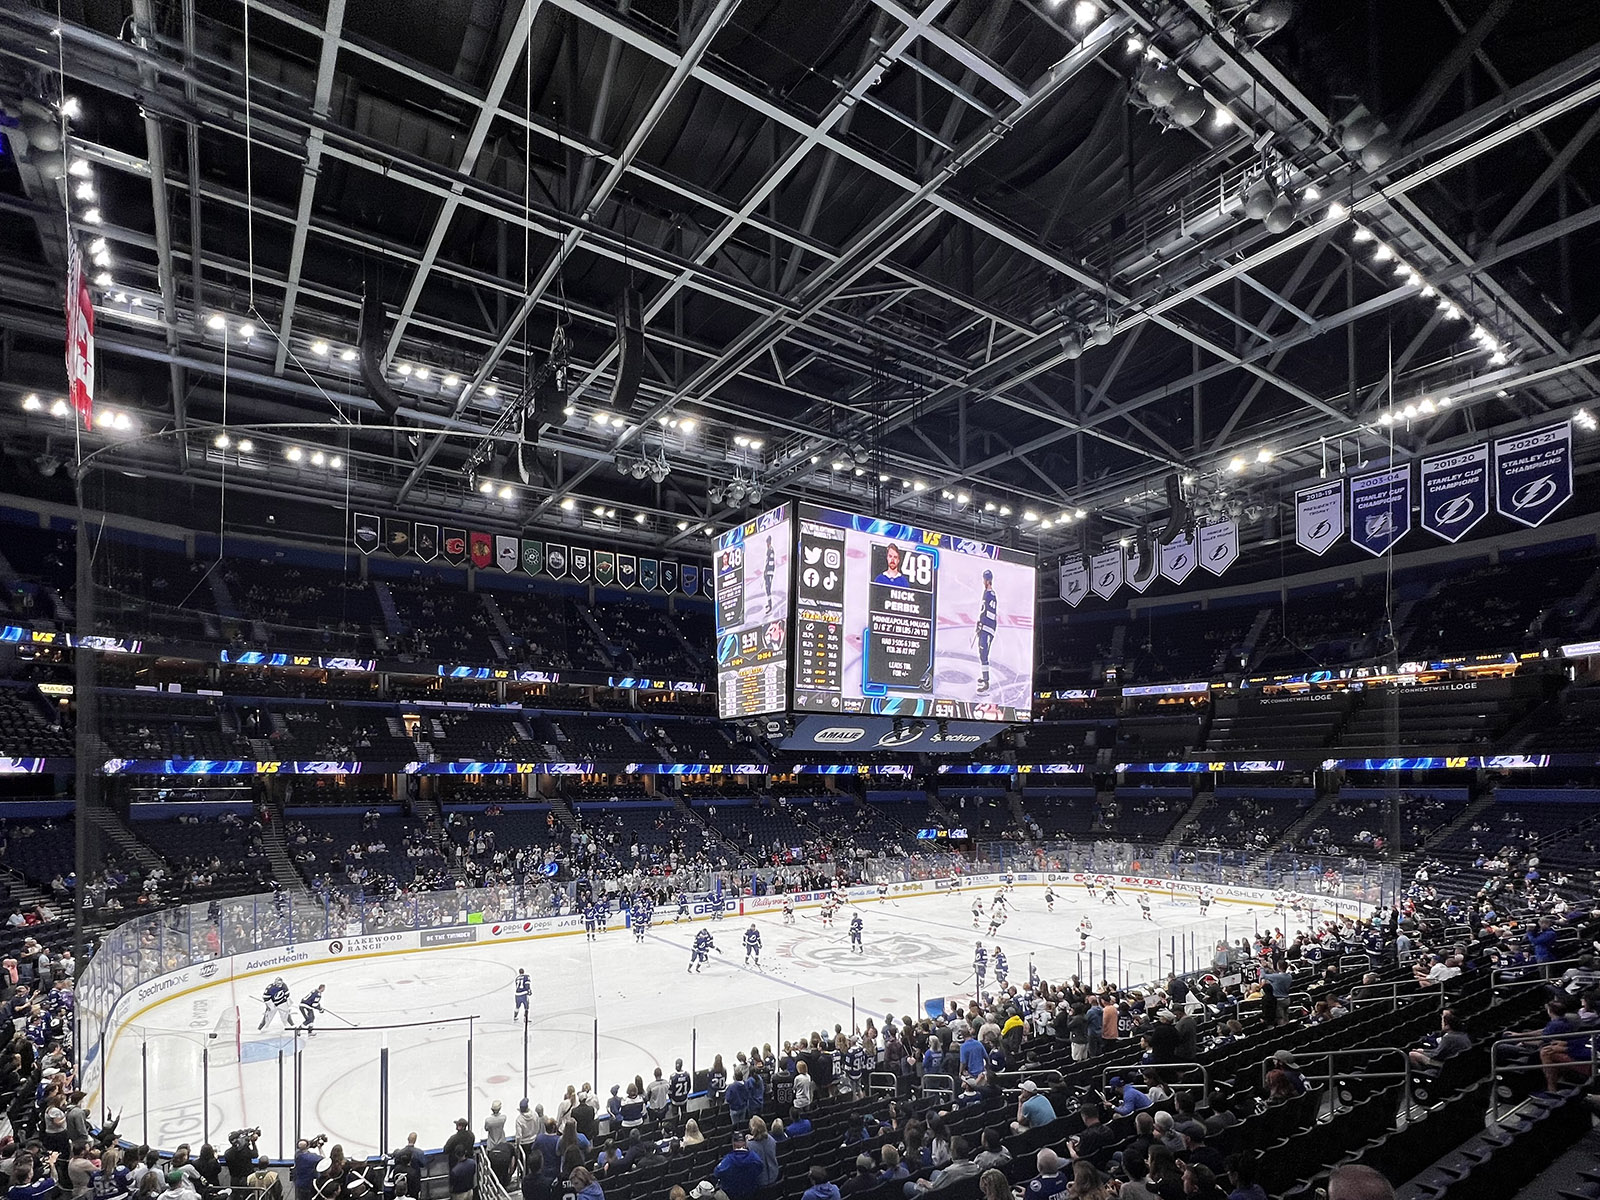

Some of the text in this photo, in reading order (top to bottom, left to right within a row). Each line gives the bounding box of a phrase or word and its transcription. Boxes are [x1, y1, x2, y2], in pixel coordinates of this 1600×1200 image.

[1509, 433, 1556, 451] 2020-21
[1433, 453, 1475, 470] 2019-20
[1502, 447, 1566, 469] STANLEY CUP
[1505, 456, 1562, 475] CHAMPIONS
[1360, 474, 1399, 488] 2003-04
[1426, 467, 1483, 487] STANLEY CUP
[1429, 476, 1480, 493] CHAMPIONS
[1355, 486, 1406, 504] STANLEY CUP
[1357, 494, 1403, 510] CHAMPIONS
[744, 522, 756, 537] VS
[922, 531, 942, 546] VS
[728, 548, 742, 568] 48
[900, 551, 932, 586] 48
[890, 589, 916, 602] NICK
[884, 600, 920, 614] PERBIX
[32, 631, 56, 643] VS
[294, 655, 313, 666] VS
[494, 669, 509, 679] VS
[653, 680, 665, 690] VS
[1450, 681, 1478, 692] LOGE
[1039, 690, 1052, 700] VS
[1310, 694, 1332, 702] LOGE
[935, 704, 954, 717] 9:34
[819, 731, 861, 741] AMALIE
[255, 761, 282, 774] VS
[515, 762, 536, 774] VS
[709, 763, 724, 774] VS
[1208, 761, 1226, 772] VS
[1445, 757, 1469, 768] VS
[857, 764, 870, 775] VS
[1017, 764, 1033, 774] VS
[936, 829, 948, 838] VS
[1121, 876, 1163, 886] DEX DEX
[1225, 889, 1265, 899] ASHLEY
[83, 898, 93, 906] 21
[534, 921, 553, 929] pepsi
[347, 934, 403, 945] LAKEWOOD
[347, 943, 382, 953] RANCH
[246, 951, 309, 971] AdventHealth
[711, 1077, 727, 1089] 20
[675, 1082, 688, 1097] 21
